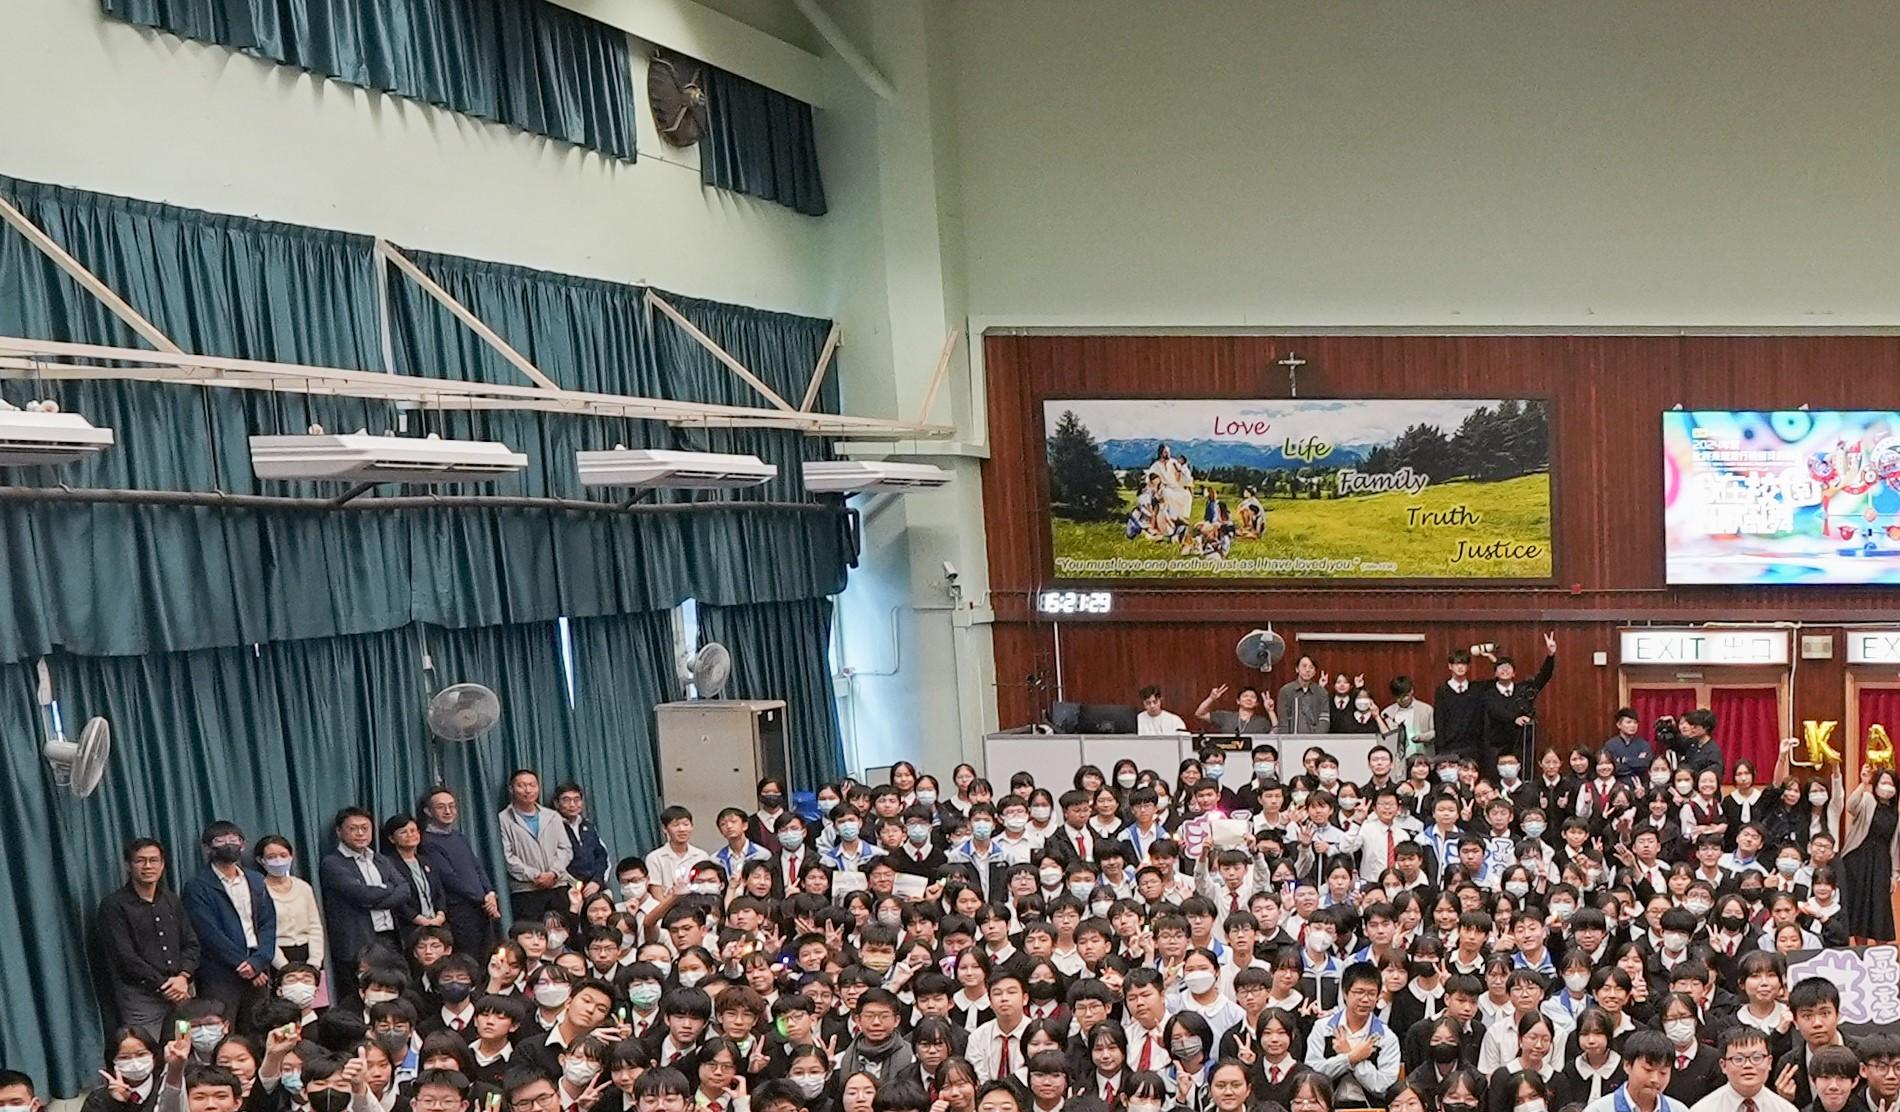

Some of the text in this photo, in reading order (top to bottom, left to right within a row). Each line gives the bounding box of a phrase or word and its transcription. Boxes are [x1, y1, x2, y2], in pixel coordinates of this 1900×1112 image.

[1214, 416, 1271, 436] Love
[1283, 436, 1332, 462] Life
[1338, 470, 1428, 496] Family
[1407, 506, 1480, 527] Truth
[1451, 540, 1542, 563] Justice
[1086, 559, 1115, 570] must
[1116, 558, 1141, 570] love
[1144, 560, 1166, 570] one
[1169, 558, 1214, 570] another
[1214, 559, 1237, 572] just
[1239, 560, 1253, 570] as
[1265, 558, 1293, 570] have
[1295, 558, 1328, 570] loved
[1637, 636, 1771, 660] EXIT 出口
